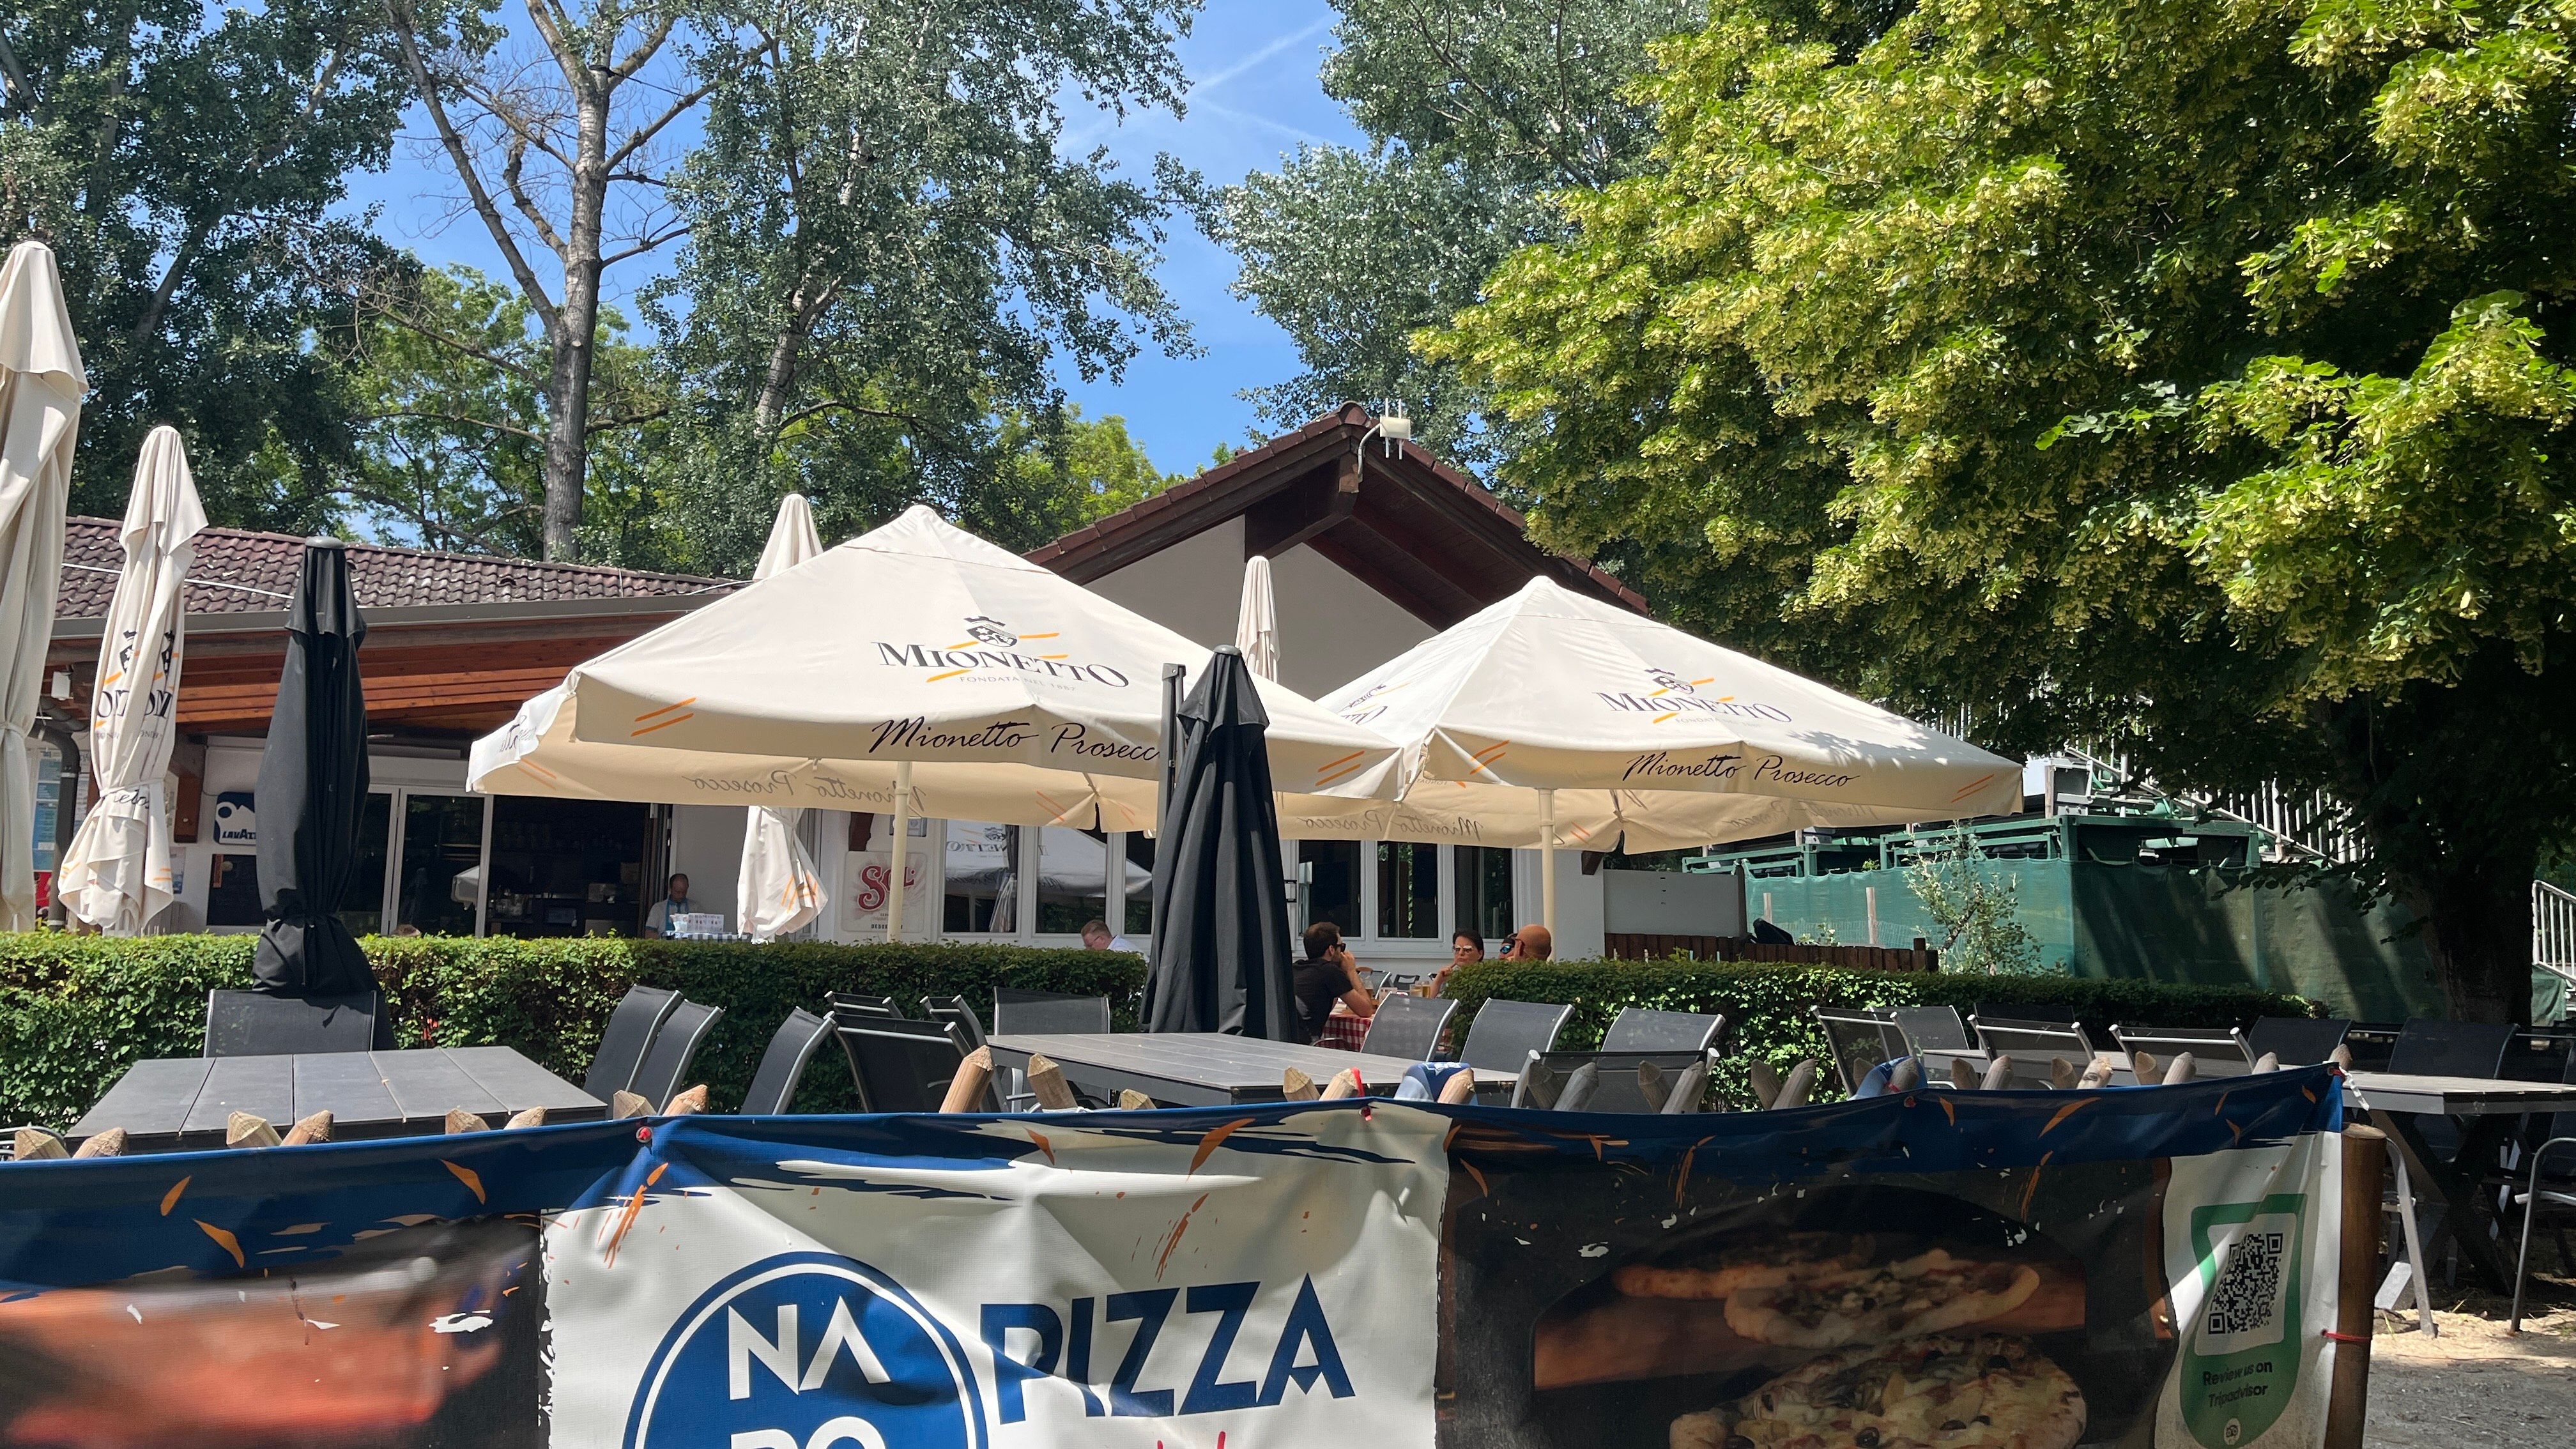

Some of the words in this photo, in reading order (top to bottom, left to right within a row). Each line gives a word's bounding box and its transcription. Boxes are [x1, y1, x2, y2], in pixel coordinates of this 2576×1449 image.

[871, 641, 1130, 688] MIONETTO
[1591, 692, 1792, 723] MIONETTO
[868, 716, 1039, 753] Mionetto
[1050, 721, 1160, 761] Prosecc
[1622, 751, 1747, 781] Mionetto
[1754, 755, 1860, 787] Prosecco
[222, 829, 256, 839] LAVAZ
[980, 1272, 1356, 1425] PIZZA
[2203, 1367, 2242, 1386] Review
[2256, 1361, 2273, 1373] on
[2208, 1382, 2268, 1409] Tripadvisor
